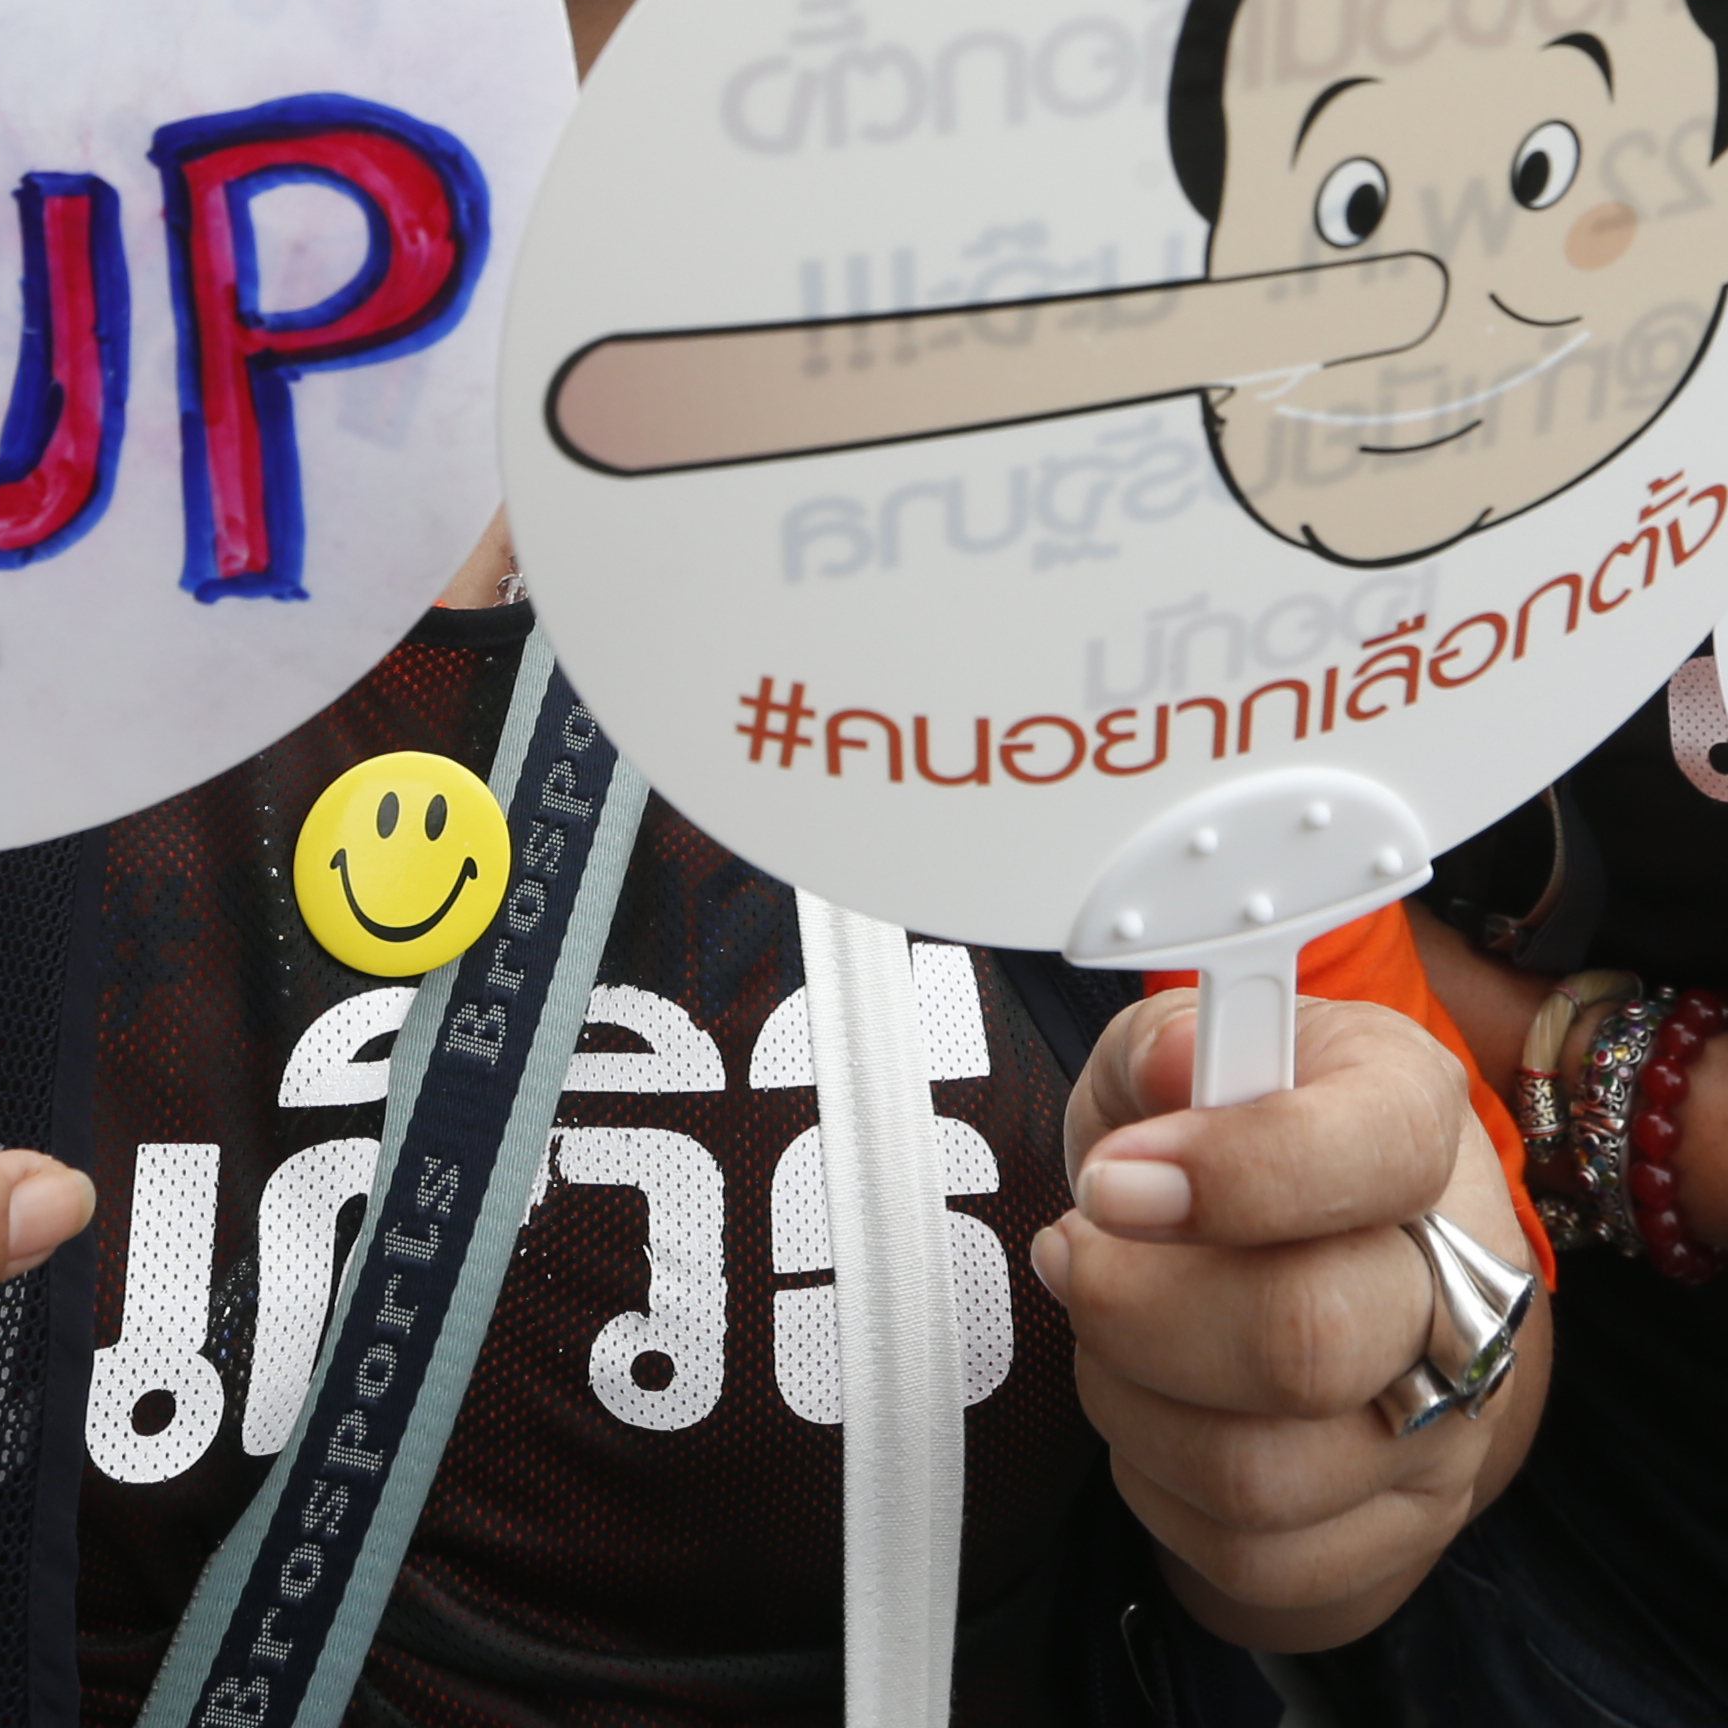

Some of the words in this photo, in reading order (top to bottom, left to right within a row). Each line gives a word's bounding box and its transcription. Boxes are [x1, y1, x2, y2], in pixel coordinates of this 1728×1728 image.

[737, 471, 1728, 787] #คนอยากเลือกตั้ง
